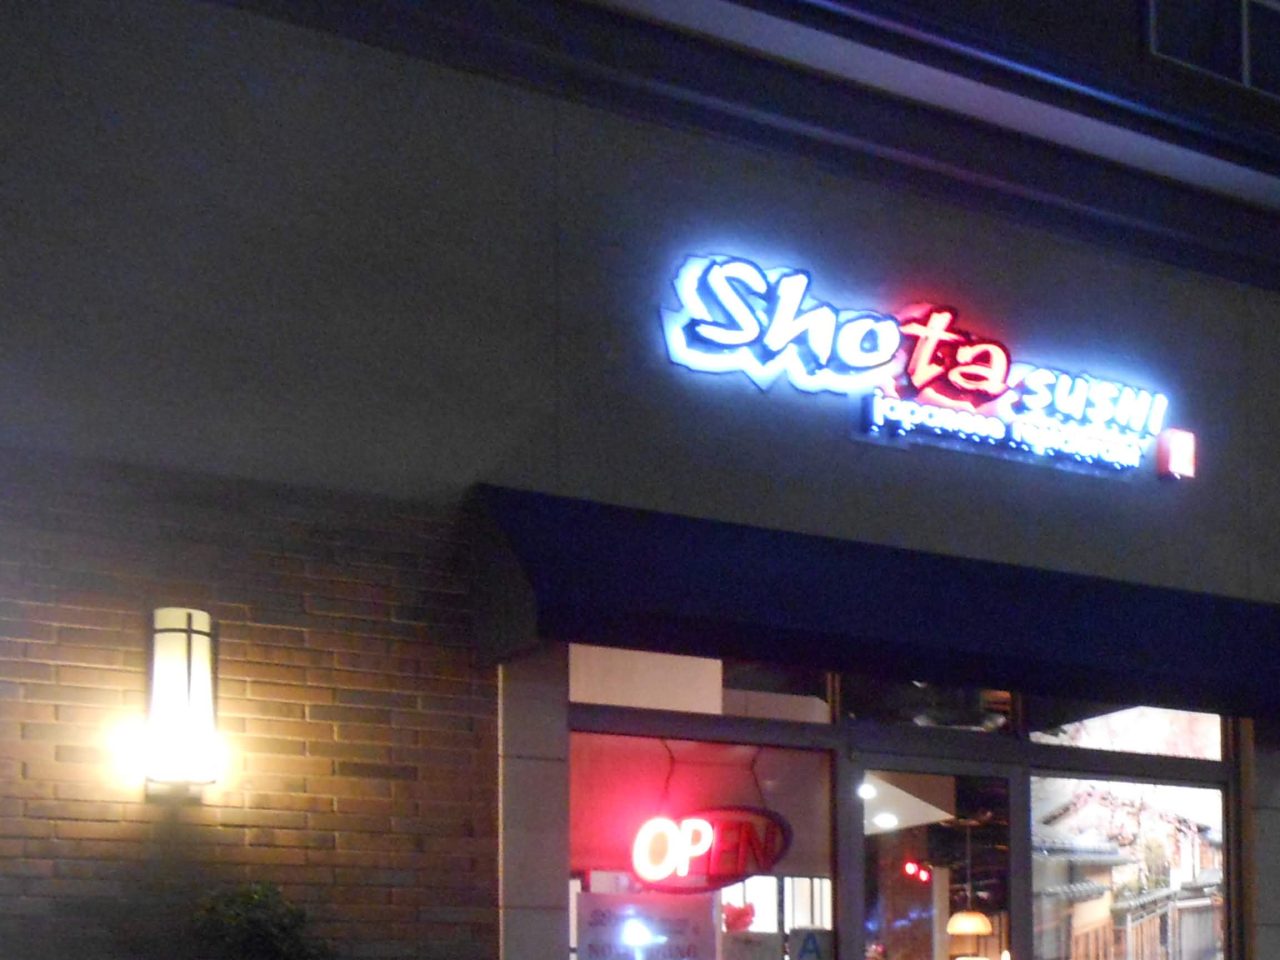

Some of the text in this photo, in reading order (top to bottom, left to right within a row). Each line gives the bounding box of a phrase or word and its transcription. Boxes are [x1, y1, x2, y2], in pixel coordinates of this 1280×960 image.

[694, 258, 1012, 396] Shota
[633, 817, 774, 882] OPEN
[797, 930, 823, 960] A
